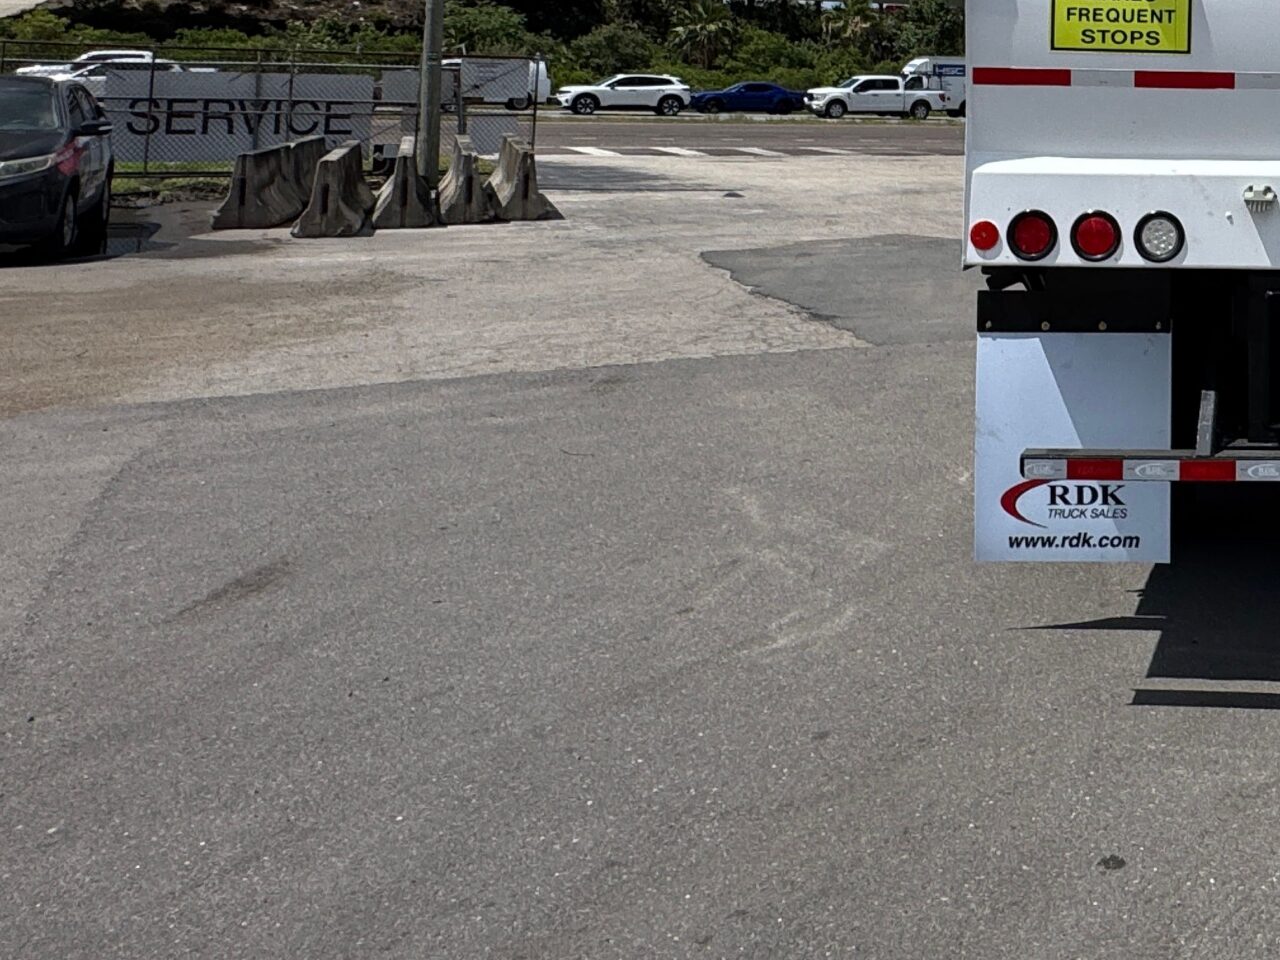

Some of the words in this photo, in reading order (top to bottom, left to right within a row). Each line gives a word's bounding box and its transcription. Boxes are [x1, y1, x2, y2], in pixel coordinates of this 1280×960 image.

[1066, 7, 1176, 24] FREQUENT
[1080, 29, 1161, 46] STOPS
[126, 98, 354, 135] SERVICE
[1047, 484, 1126, 506] RDK
[1048, 508, 1087, 519] TRUCK
[1090, 508, 1128, 519] SALES
[1008, 532, 1140, 548] www.rdk.com
